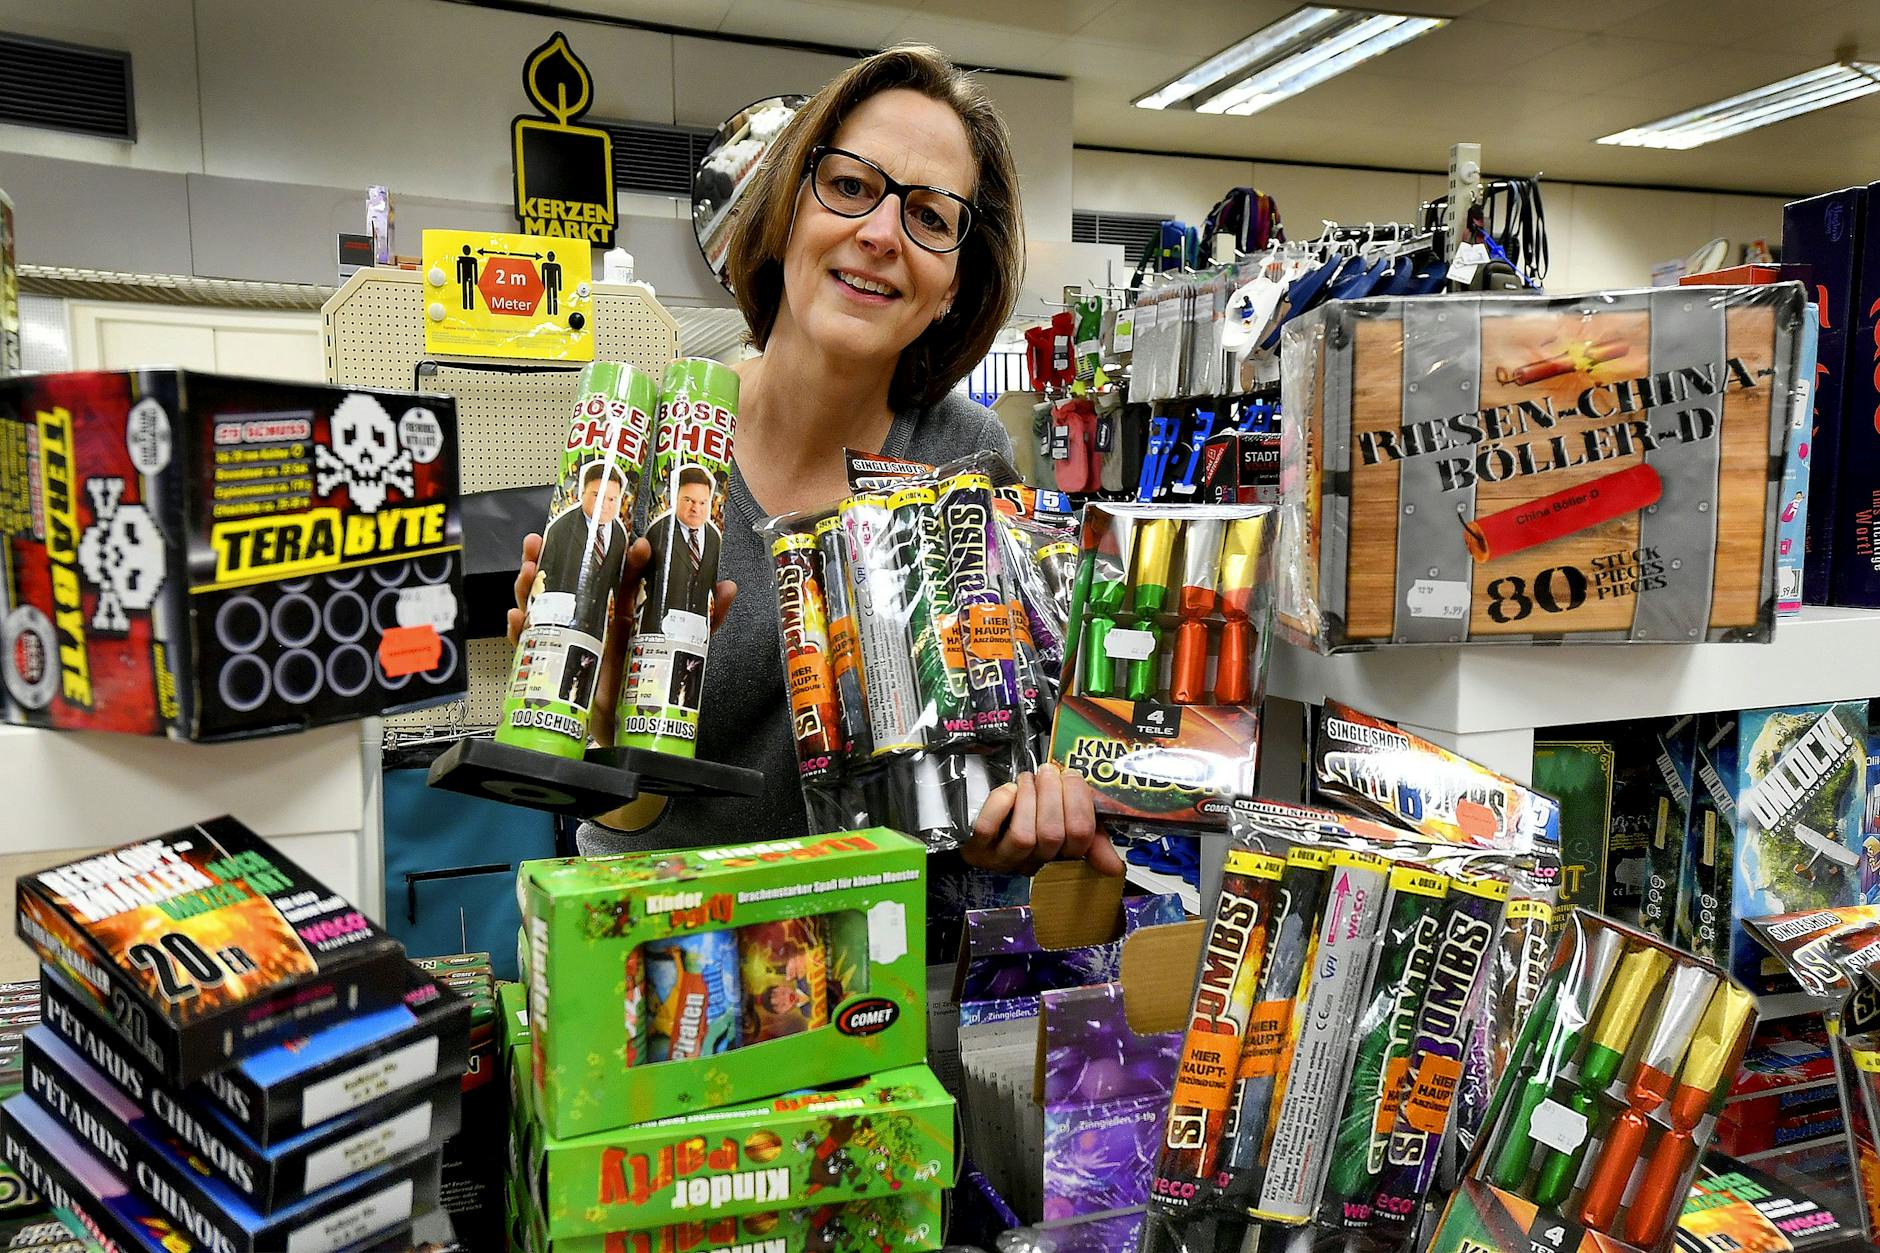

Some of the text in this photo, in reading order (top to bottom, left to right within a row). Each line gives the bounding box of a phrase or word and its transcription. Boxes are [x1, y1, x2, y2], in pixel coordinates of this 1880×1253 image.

[525, 197, 614, 224] KERZEN
[525, 217, 613, 243] MARKT
[496, 270, 526, 286] 2 m
[491, 297, 532, 311] Meter
[1245, 451, 1279, 462] STADT
[1440, 408, 1717, 493] BÖLLER-D
[854, 460, 926, 475] SINGLE SHOTS
[1043, 491, 1060, 507] 5
[1516, 489, 1599, 526] China Böller D
[1856, 509, 1873, 556] Wort!
[1595, 561, 1664, 586] PIECES
[1487, 566, 1588, 624] 80
[1598, 575, 1667, 600] PIECES
[983, 616, 1008, 626] HIER
[511, 711, 584, 738] 100 SCHUSS
[626, 718, 696, 738] 100 SCHUSS
[1147, 710, 1165, 724] 4
[1137, 725, 1174, 735] TEILE
[1329, 720, 1408, 750] SINGLE SHOTS
[1750, 707, 1854, 831] UNLOCK!
[1700, 765, 1735, 813] UNLOCK!
[1769, 744, 1858, 838] ESCAPE ADVENTURES
[1204, 804, 1230, 813] COME
[645, 891, 704, 914] Kinder
[1769, 912, 1841, 941] SINGLE SHOTS
[127, 932, 226, 1005] 20
[1321, 955, 1338, 979] VPI
[850, 1007, 894, 1028] COMET
[987, 1009, 1033, 1022] Zinngießen,
[1191, 1049, 1221, 1064] HIER
[151, 1088, 254, 1193] CHINOIS
[599, 1136, 739, 1206] Party
[671, 1168, 790, 1209] Kinder
[1543, 1226, 1566, 1247] 4
